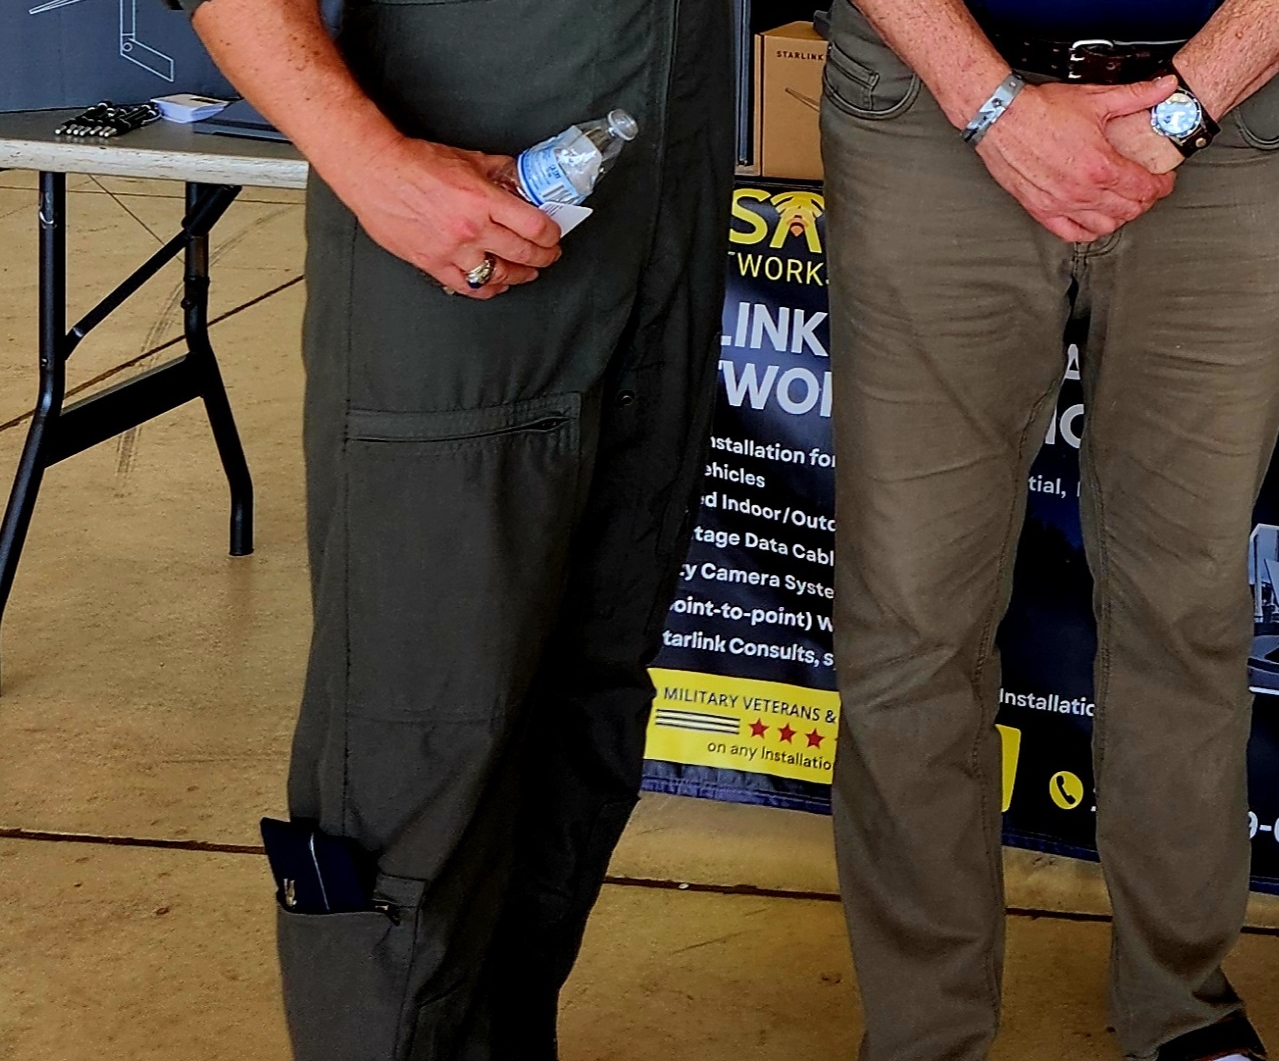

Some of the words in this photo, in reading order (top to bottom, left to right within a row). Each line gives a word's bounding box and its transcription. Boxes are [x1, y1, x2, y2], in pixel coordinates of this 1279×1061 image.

[776, 50, 824, 61] STARLINK
[728, 252, 830, 286] WORK
[718, 359, 833, 418] WO
[1028, 474, 1067, 498] tial,
[693, 525, 741, 548] tage
[745, 532, 789, 556] Data
[792, 544, 835, 567] Cabl
[701, 562, 781, 588] Camera
[784, 574, 834, 599] Syste
[669, 596, 812, 631] oint-to-point)
[661, 629, 726, 653] tarlink
[729, 638, 820, 668] Consults,
[663, 687, 739, 709] MILITARY
[743, 696, 821, 721] VETERANS
[824, 709, 837, 724] &
[707, 742, 726, 753] on
[730, 745, 758, 761] any
